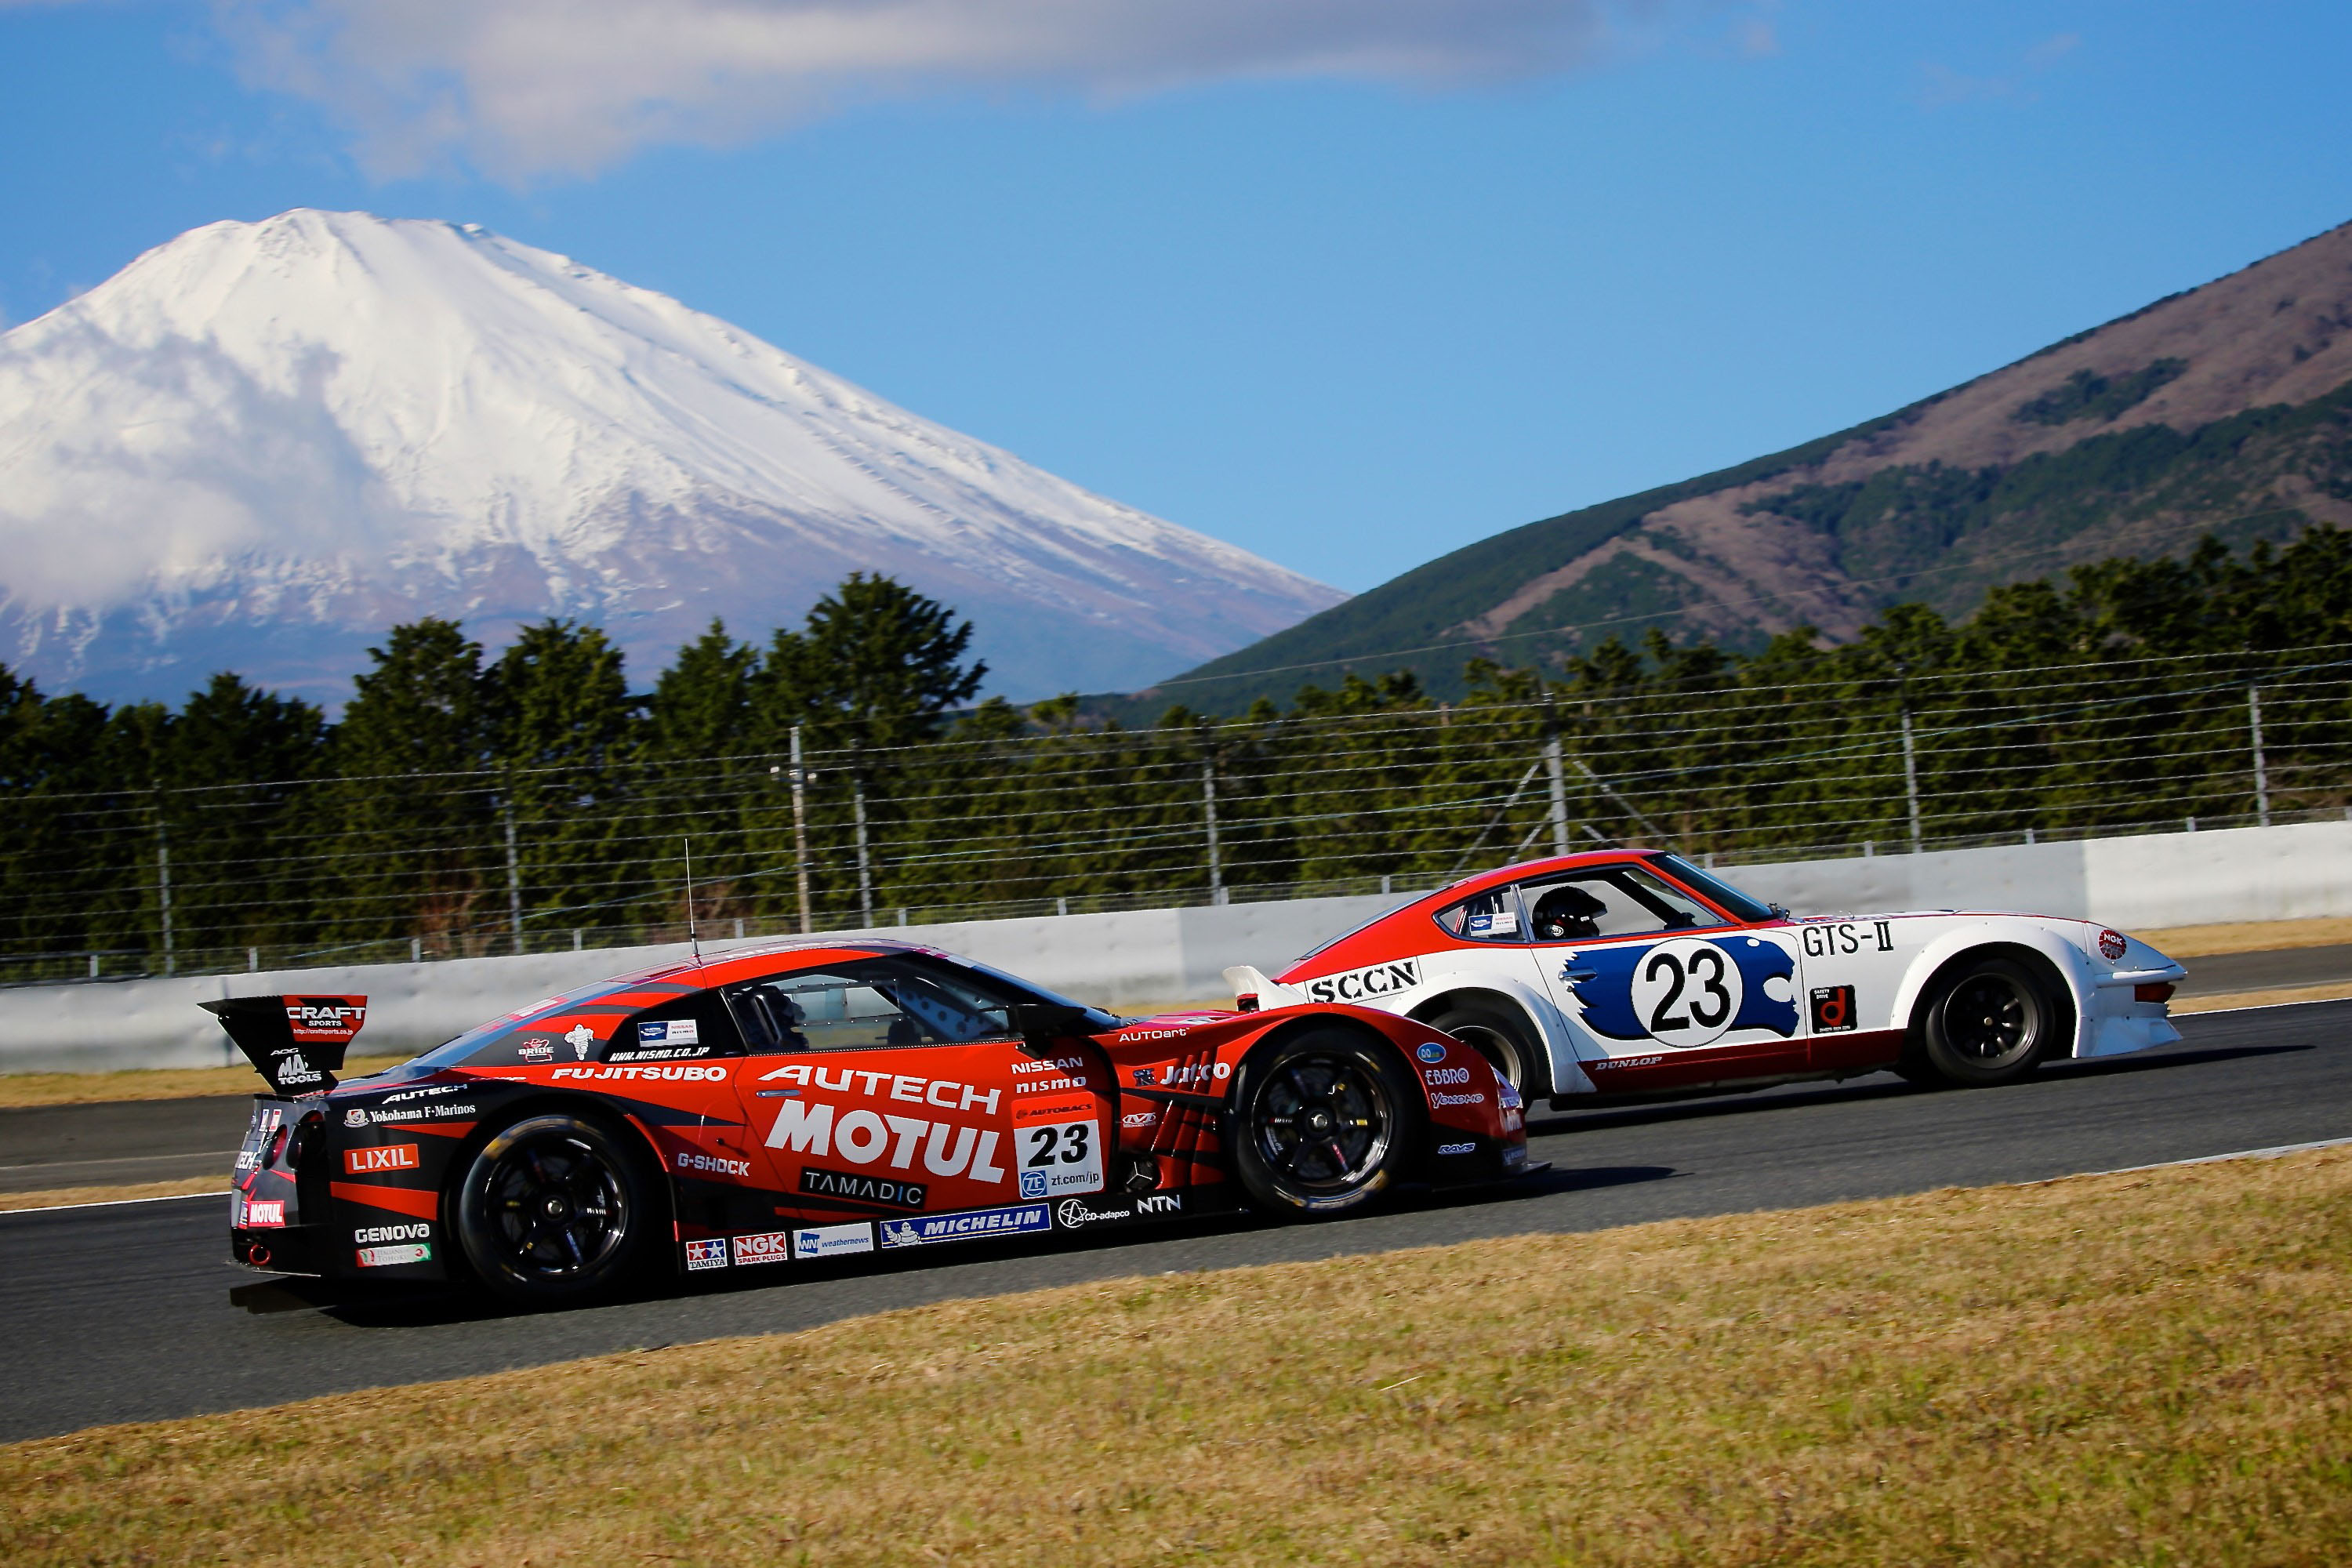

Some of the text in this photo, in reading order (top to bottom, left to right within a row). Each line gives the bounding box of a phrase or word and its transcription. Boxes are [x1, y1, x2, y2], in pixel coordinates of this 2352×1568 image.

[2103, 933, 2122, 946] NGK
[1311, 961, 1417, 1004] SCCN
[1646, 948, 1730, 1033] 23
[285, 1007, 366, 1019] CRAFT
[517, 1047, 554, 1055] BRIDE
[608, 1047, 710, 1062] WWW.NISMO.CO.JP
[1011, 1057, 1083, 1075] NISSAN
[1595, 1056, 1663, 1071] DUNLOP
[278, 1073, 322, 1085] TOOLS
[551, 1066, 727, 1082] FUJITSUBO
[1425, 1067, 1470, 1086] EBBRO
[382, 1083, 468, 1105] AUTECH
[757, 1065, 1001, 1116] AUTECH
[1016, 1076, 1087, 1094] nismo
[370, 1109, 423, 1123] Yokohama
[1029, 1103, 1093, 1116] AUTOBACS
[764, 1098, 1005, 1184] MOTUL
[1028, 1123, 1089, 1168] 23
[351, 1148, 413, 1171] LIXIL
[677, 1152, 750, 1177] G-SHOCK
[805, 1172, 923, 1205] TAMADIC
[250, 1203, 283, 1223] MOTUL
[1137, 1194, 1181, 1214] NTN
[924, 1210, 1042, 1236] MICHELIN
[735, 1234, 785, 1257] NGK
[821, 1237, 869, 1248] weathernews
[689, 1258, 726, 1269] TAMIYA
[738, 1256, 761, 1265] SPARK
